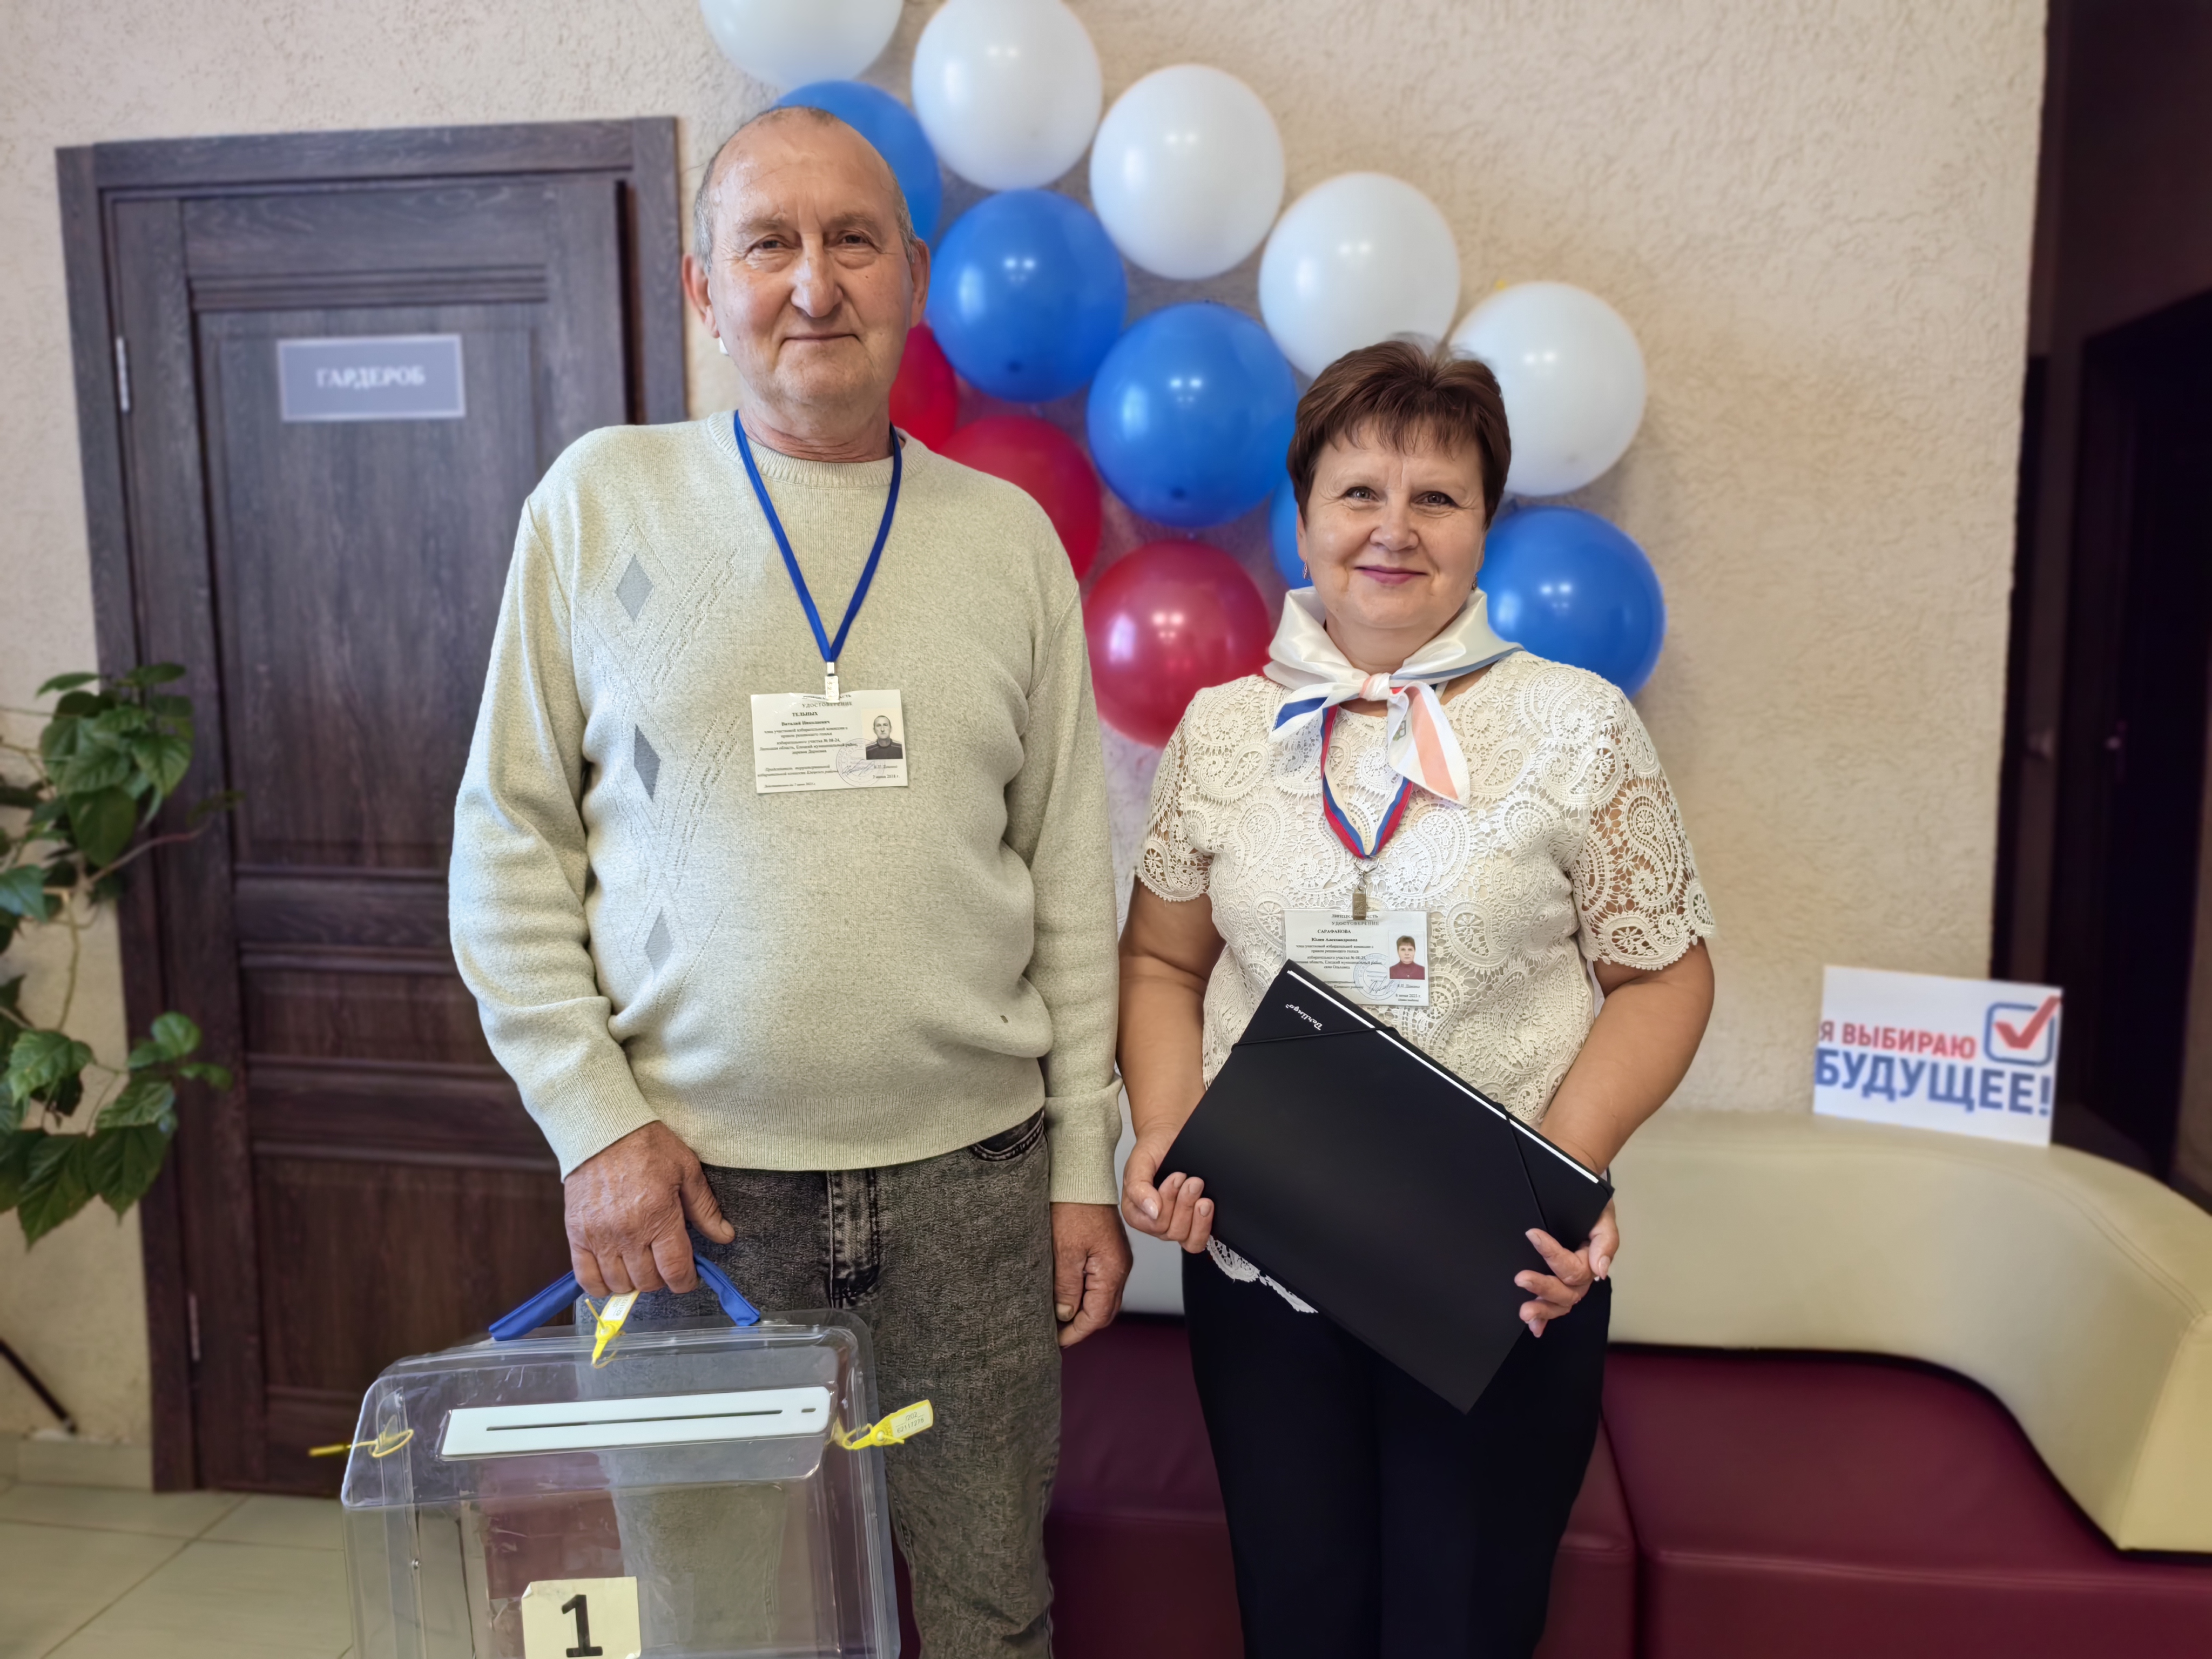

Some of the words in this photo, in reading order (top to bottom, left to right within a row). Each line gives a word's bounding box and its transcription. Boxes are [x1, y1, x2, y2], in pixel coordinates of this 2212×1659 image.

[316, 366, 426, 390] ГАРДЕРОБ
[1819, 1021, 1835, 1042] Я
[1842, 1022, 1977, 1060] ВЫБИРАЮ
[1814, 1047, 2052, 1117] БУДУЩЕЕ!
[562, 1594, 603, 1658] 1
